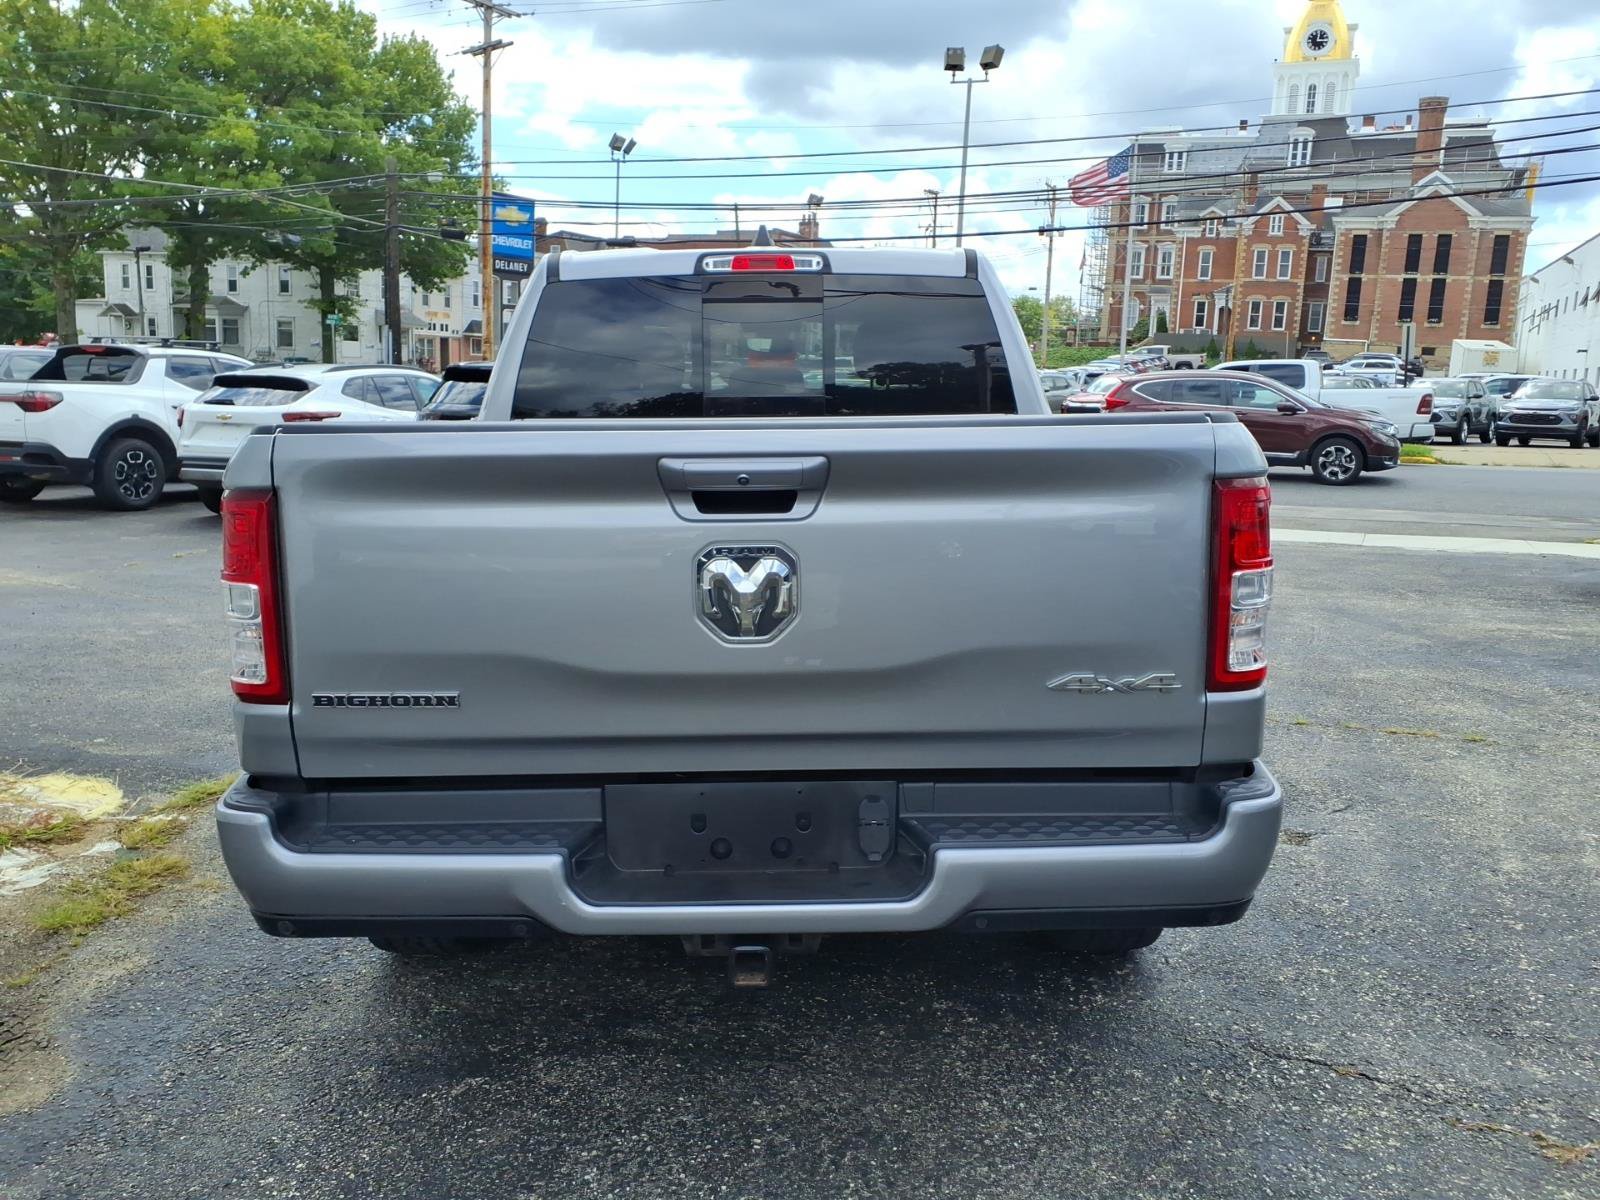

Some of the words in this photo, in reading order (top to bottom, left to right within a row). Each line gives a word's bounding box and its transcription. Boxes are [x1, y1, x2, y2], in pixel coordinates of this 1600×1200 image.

[492, 234, 533, 250] CHEVROLET
[495, 259, 529, 272] DELANEY
[311, 692, 460, 709] BIGHORN
